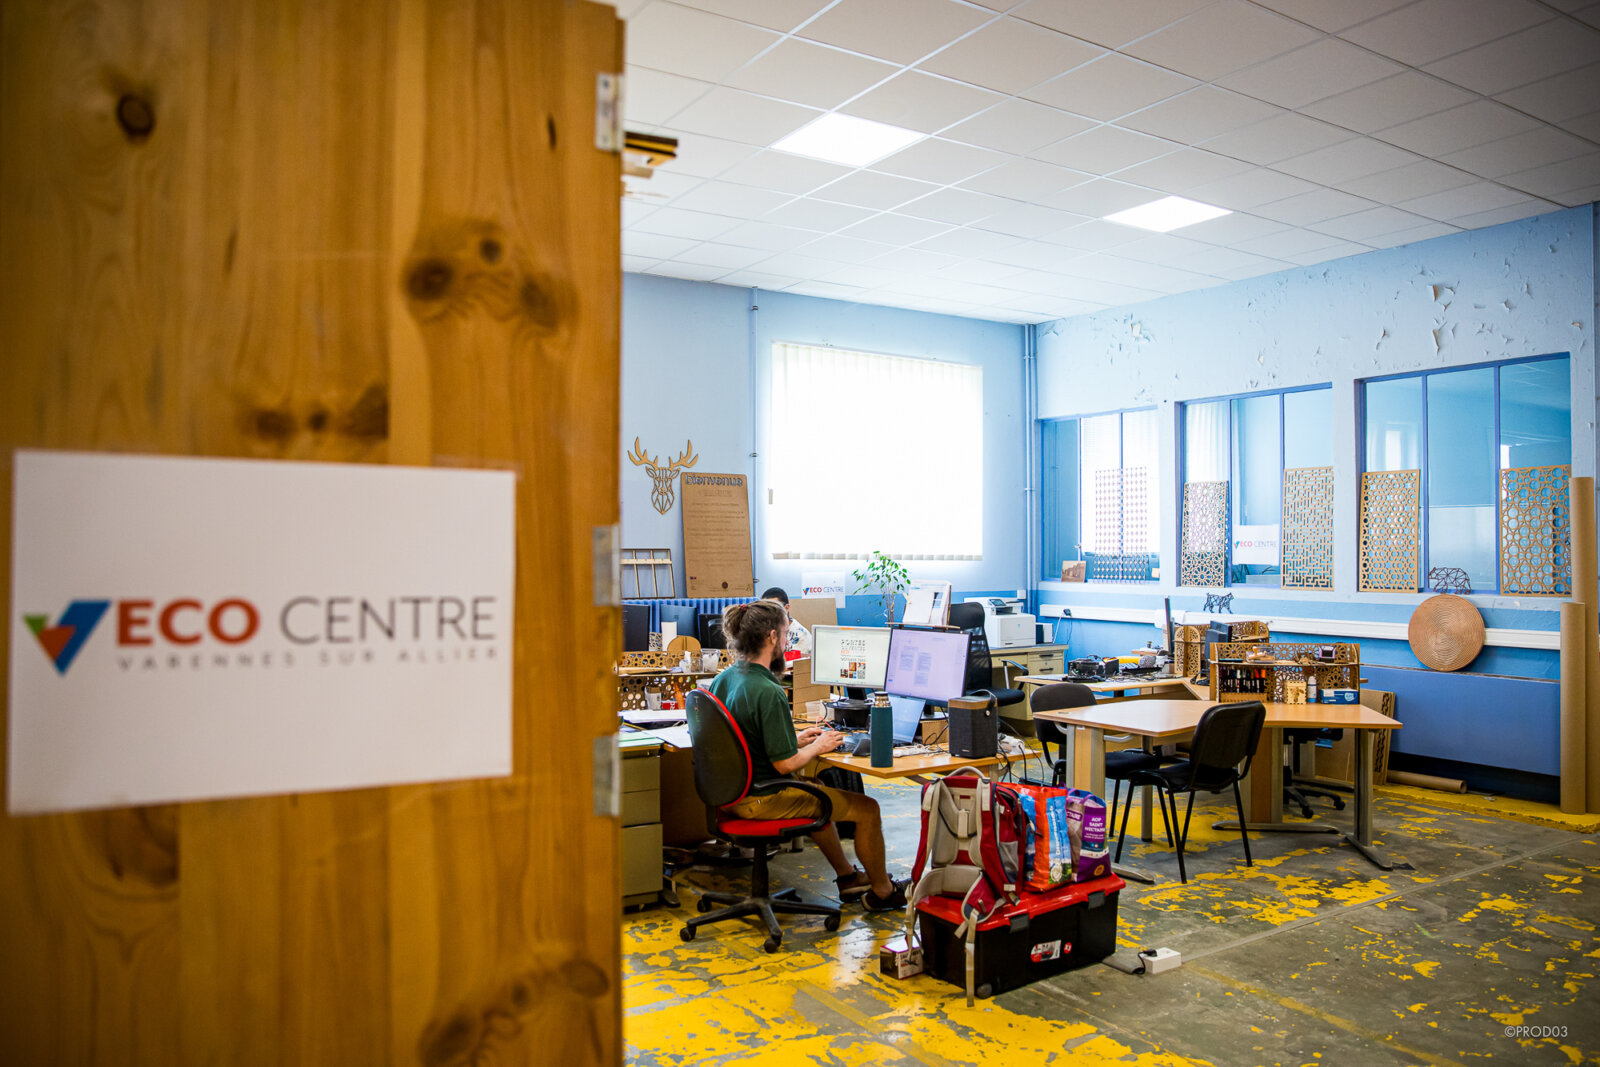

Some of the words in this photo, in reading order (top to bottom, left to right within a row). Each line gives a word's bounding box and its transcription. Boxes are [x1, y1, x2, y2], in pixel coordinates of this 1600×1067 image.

[685, 473, 743, 487] bienvenue
[117, 598, 260, 647] ECO
[280, 596, 496, 645] CENTRE
[118, 651, 295, 671] VARENNES
[319, 650, 374, 666] SUR
[399, 646, 498, 665] ALLIER
